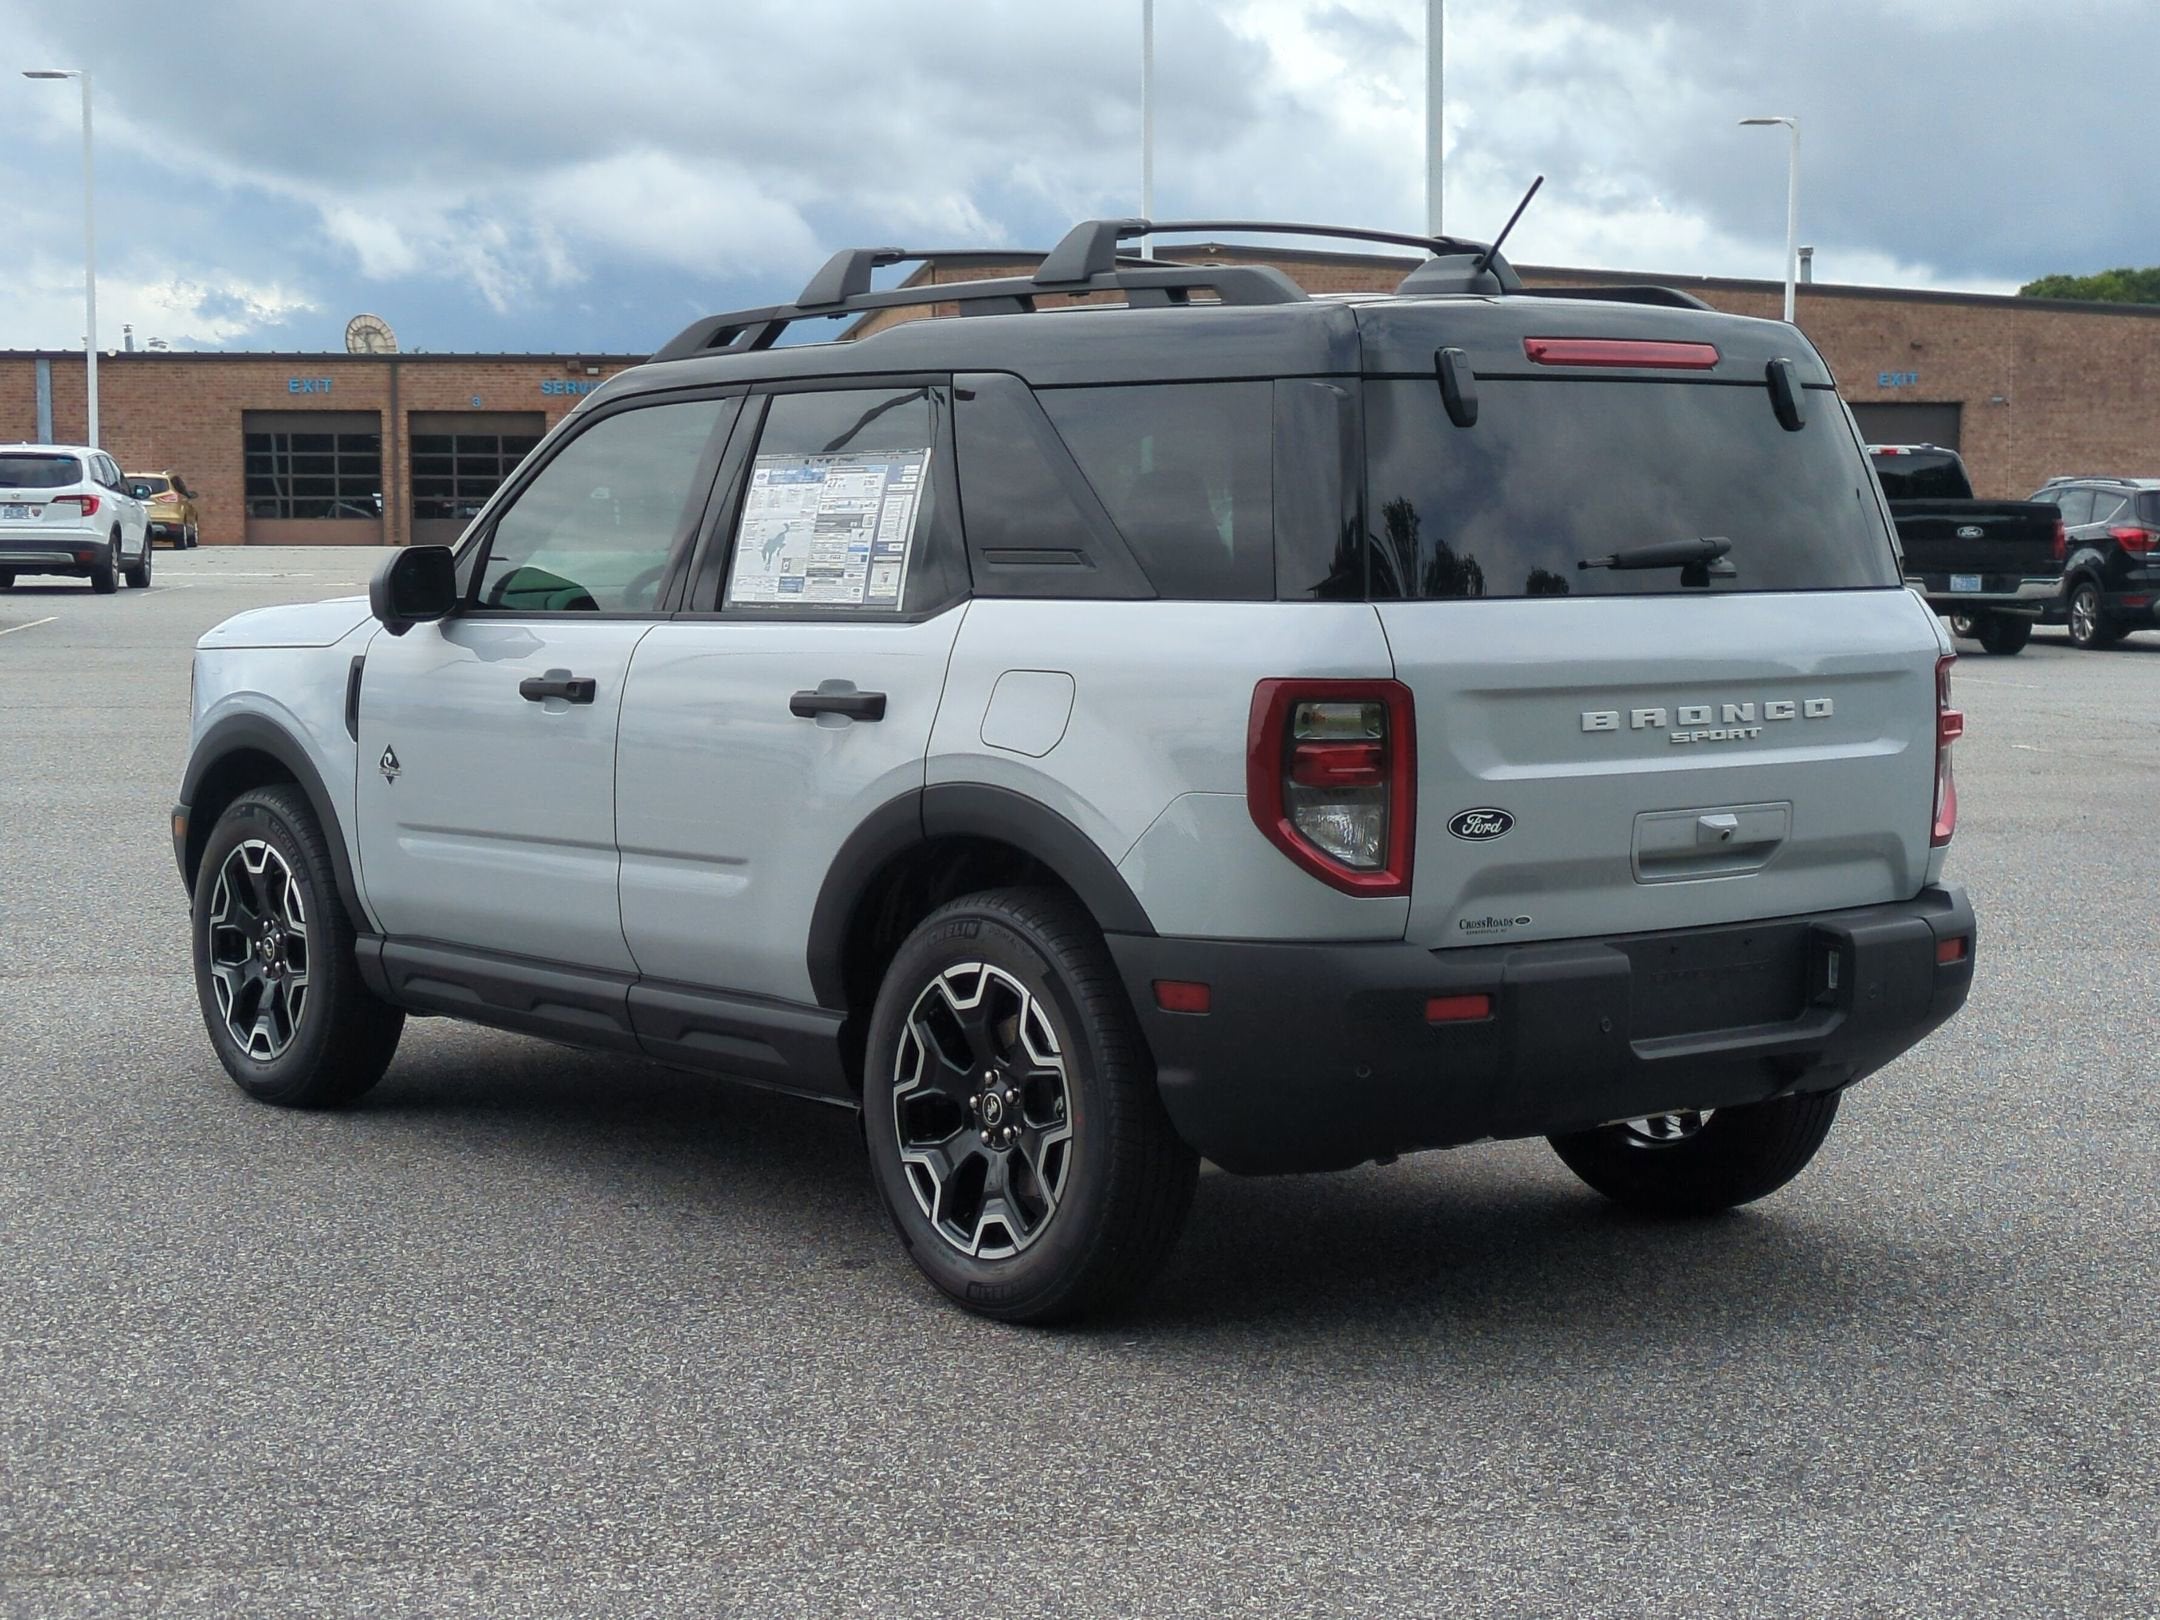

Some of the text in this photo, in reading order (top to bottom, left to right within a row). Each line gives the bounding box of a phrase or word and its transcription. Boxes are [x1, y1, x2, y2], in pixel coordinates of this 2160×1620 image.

[288, 378, 332, 394] EXIT
[1877, 370, 1918, 387] EXIT
[1581, 698, 1834, 732] BRONCO
[1670, 727, 1763, 743] SPORT
[1461, 813, 1503, 835] Ford
